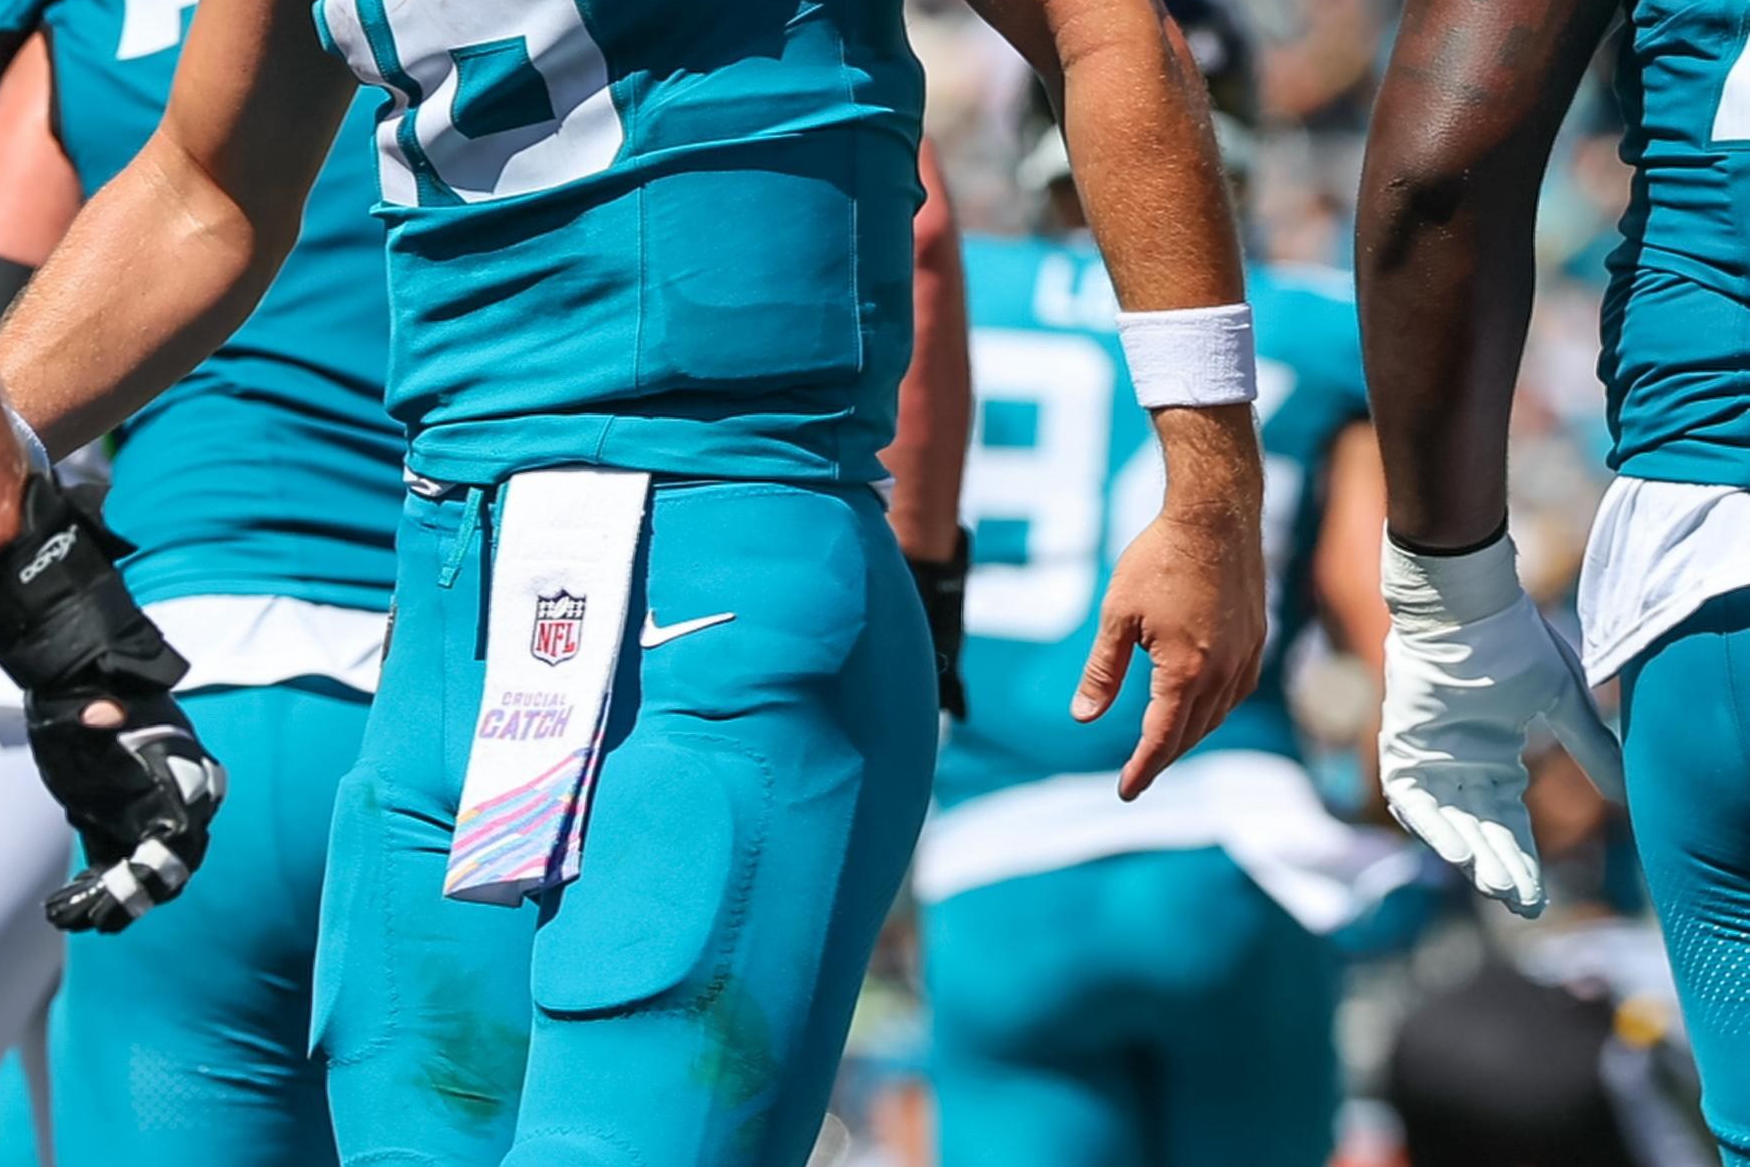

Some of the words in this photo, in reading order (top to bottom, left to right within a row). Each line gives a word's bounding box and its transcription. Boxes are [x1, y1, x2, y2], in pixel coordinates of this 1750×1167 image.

[536, 622, 576, 657] NFL
[502, 691, 566, 705] CRUCIAL
[479, 706, 573, 740] CATCH
